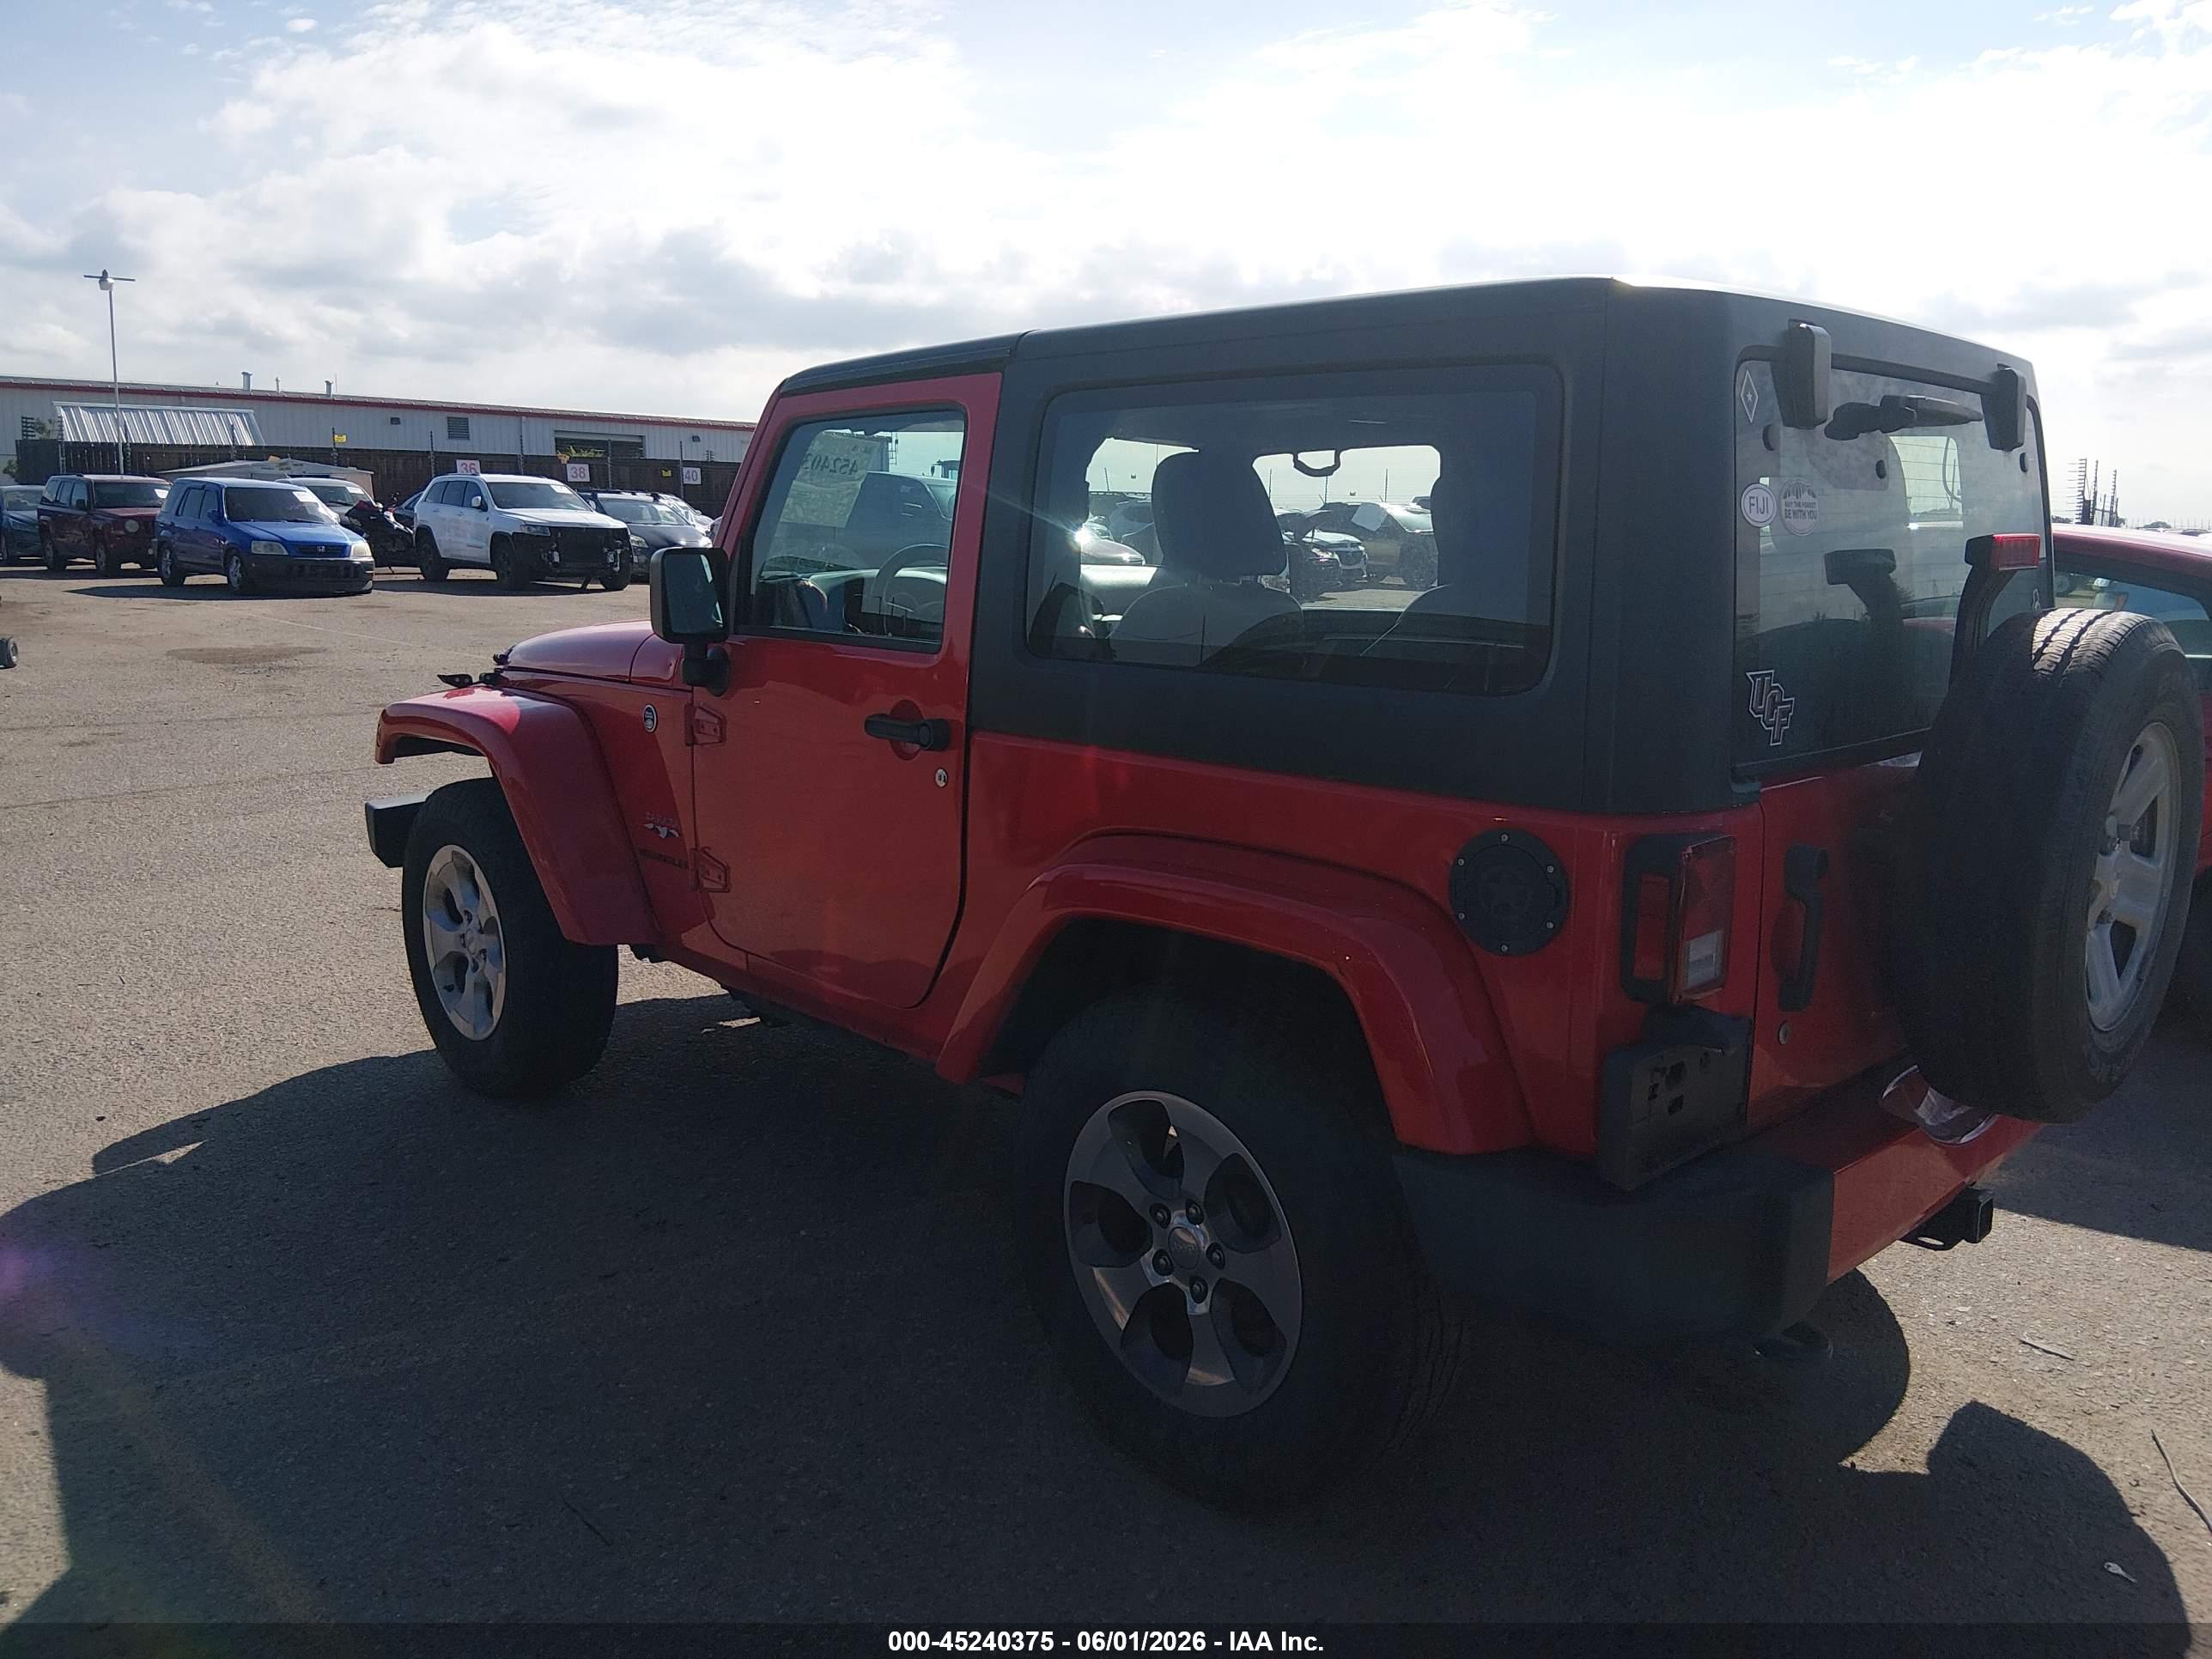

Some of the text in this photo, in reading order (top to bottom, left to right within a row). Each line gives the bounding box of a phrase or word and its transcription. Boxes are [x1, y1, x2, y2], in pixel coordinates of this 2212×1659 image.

[460, 462, 477, 474] 36
[570, 466, 586, 479] 38
[684, 470, 698, 481] 40
[1748, 495, 1769, 515] FIJI
[1784, 508, 1817, 520] BE WITH YOU
[1746, 670, 1795, 746] UCF
